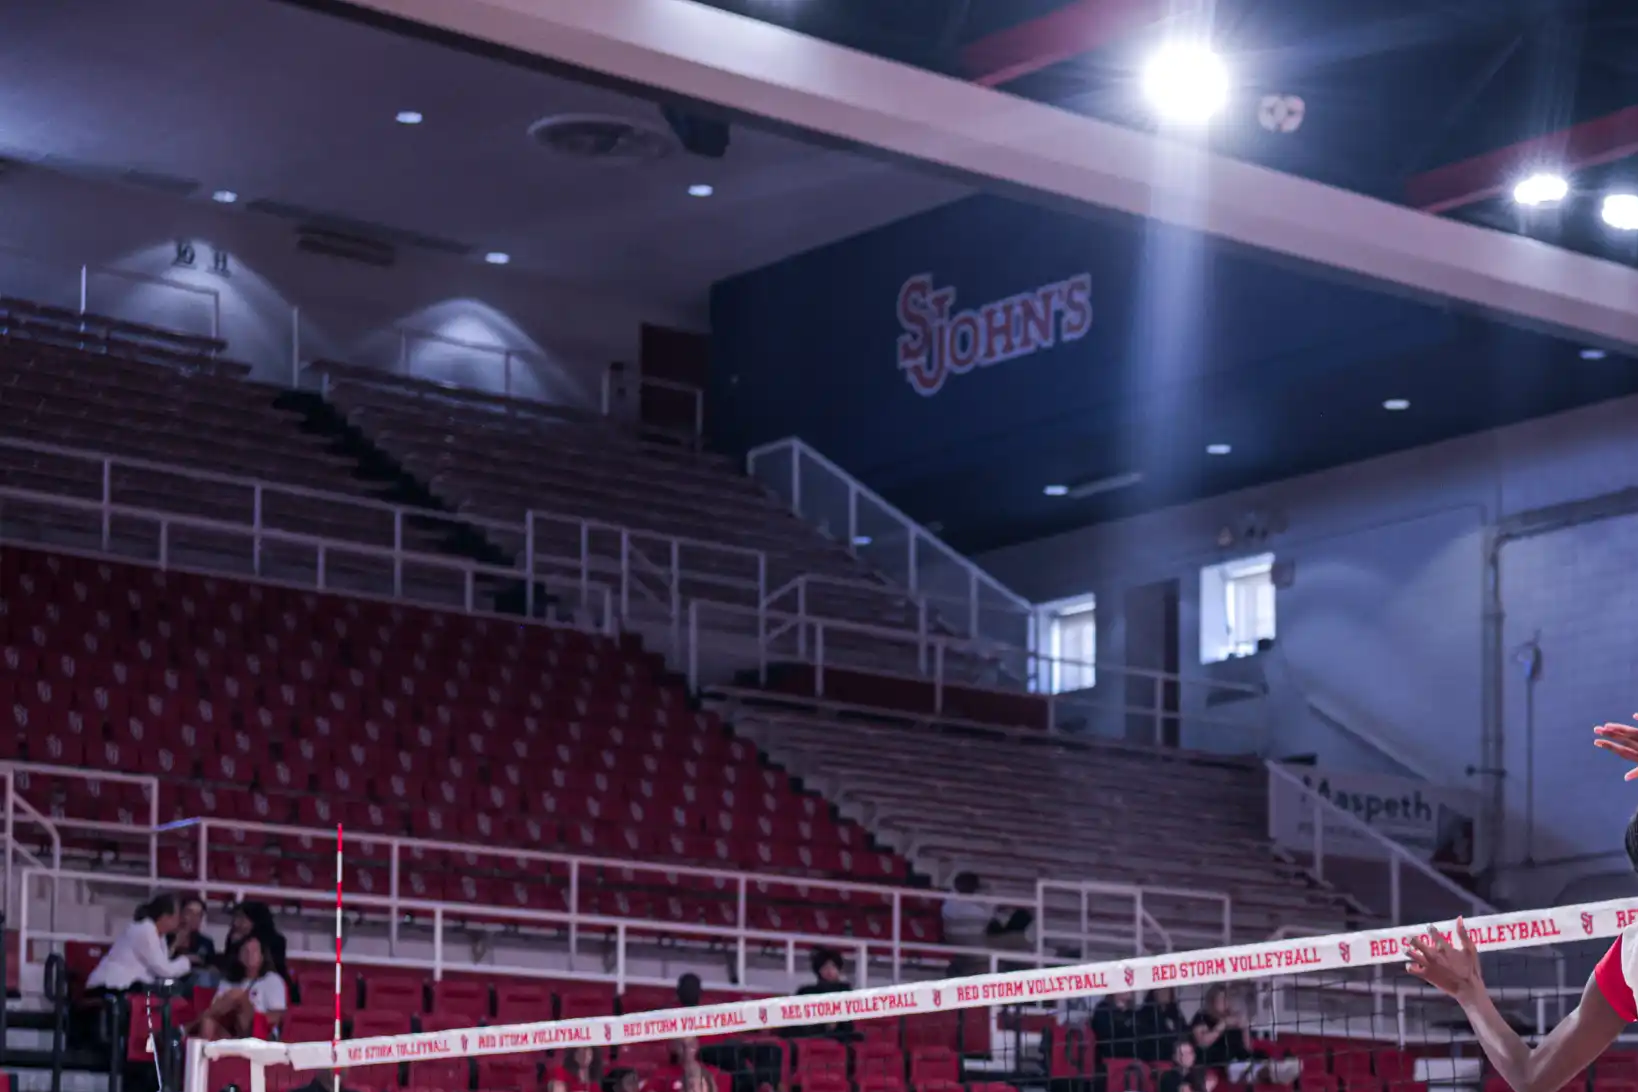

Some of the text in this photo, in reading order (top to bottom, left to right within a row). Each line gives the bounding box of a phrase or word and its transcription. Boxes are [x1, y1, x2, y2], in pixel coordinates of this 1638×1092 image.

[1369, 938, 1399, 957] RED
[1151, 964, 1177, 982] RED
[1179, 958, 1227, 979] STORM
[1228, 947, 1321, 972] VOLLEYBALL
[957, 985, 979, 1002] RED
[982, 980, 1024, 998] STORM
[1027, 972, 1108, 995] VOLLEYBALL
[781, 1005, 803, 1020] RED
[804, 1002, 841, 1018] STORM
[844, 992, 917, 1014] VOLLEYBALL
[623, 1023, 642, 1037] RED
[644, 1018, 678, 1036] STORM
[681, 1011, 746, 1031] VOLLEYBALL
